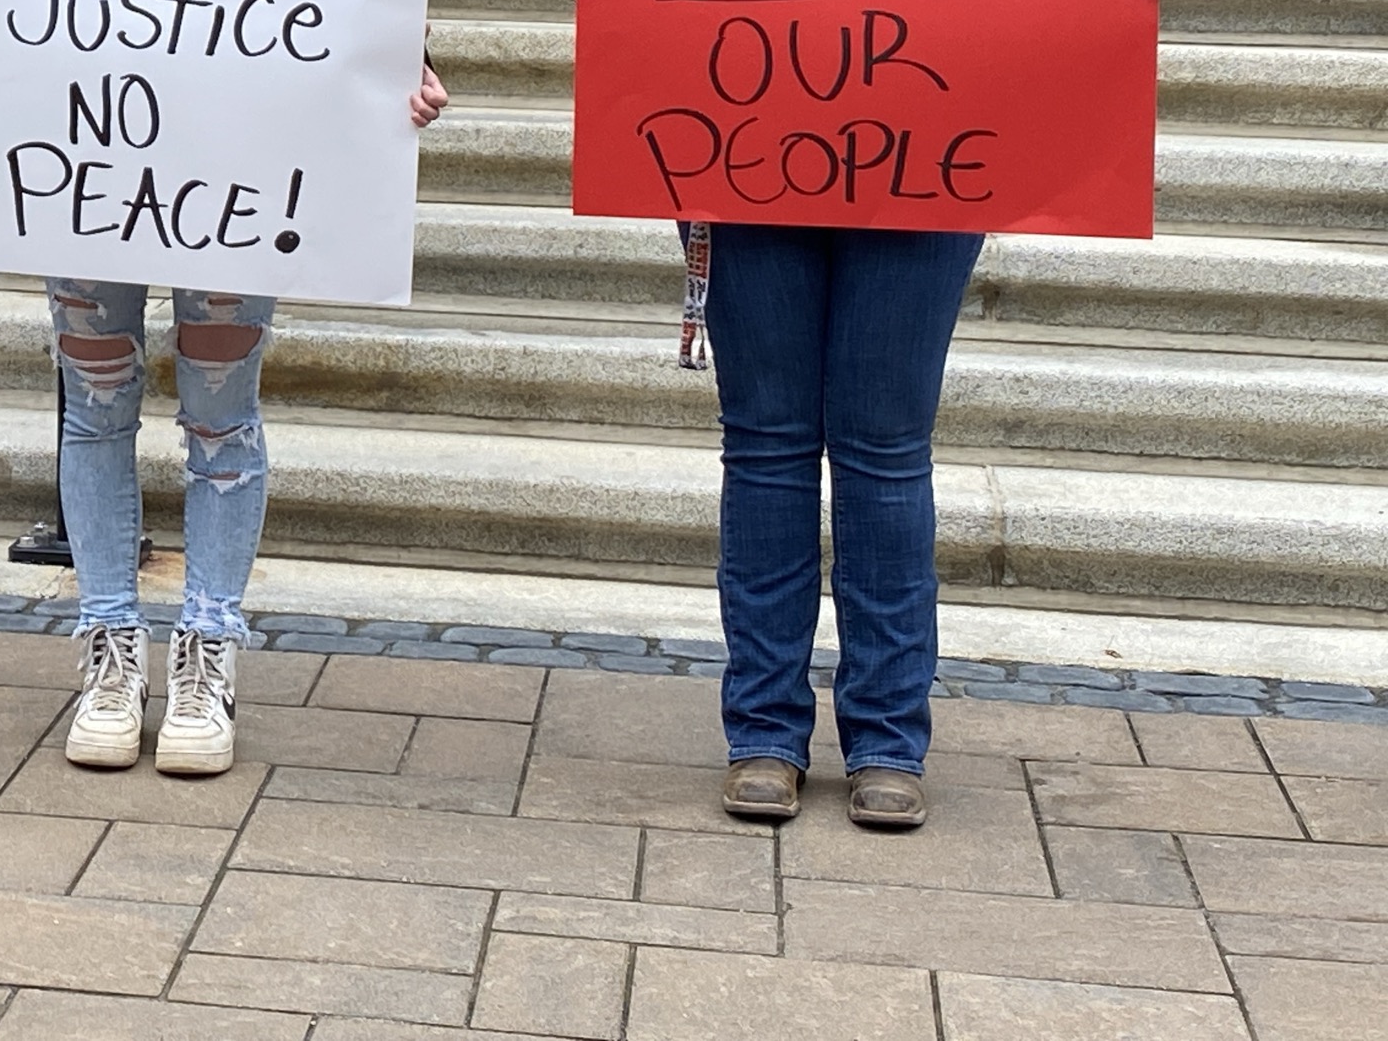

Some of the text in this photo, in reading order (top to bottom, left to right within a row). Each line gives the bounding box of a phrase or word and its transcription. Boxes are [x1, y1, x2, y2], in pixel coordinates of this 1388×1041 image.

[709, 10, 950, 106] OUR
[68, 73, 160, 149] NO
[636, 107, 998, 212] PEOPLE
[5, 140, 305, 255] PEACE!
